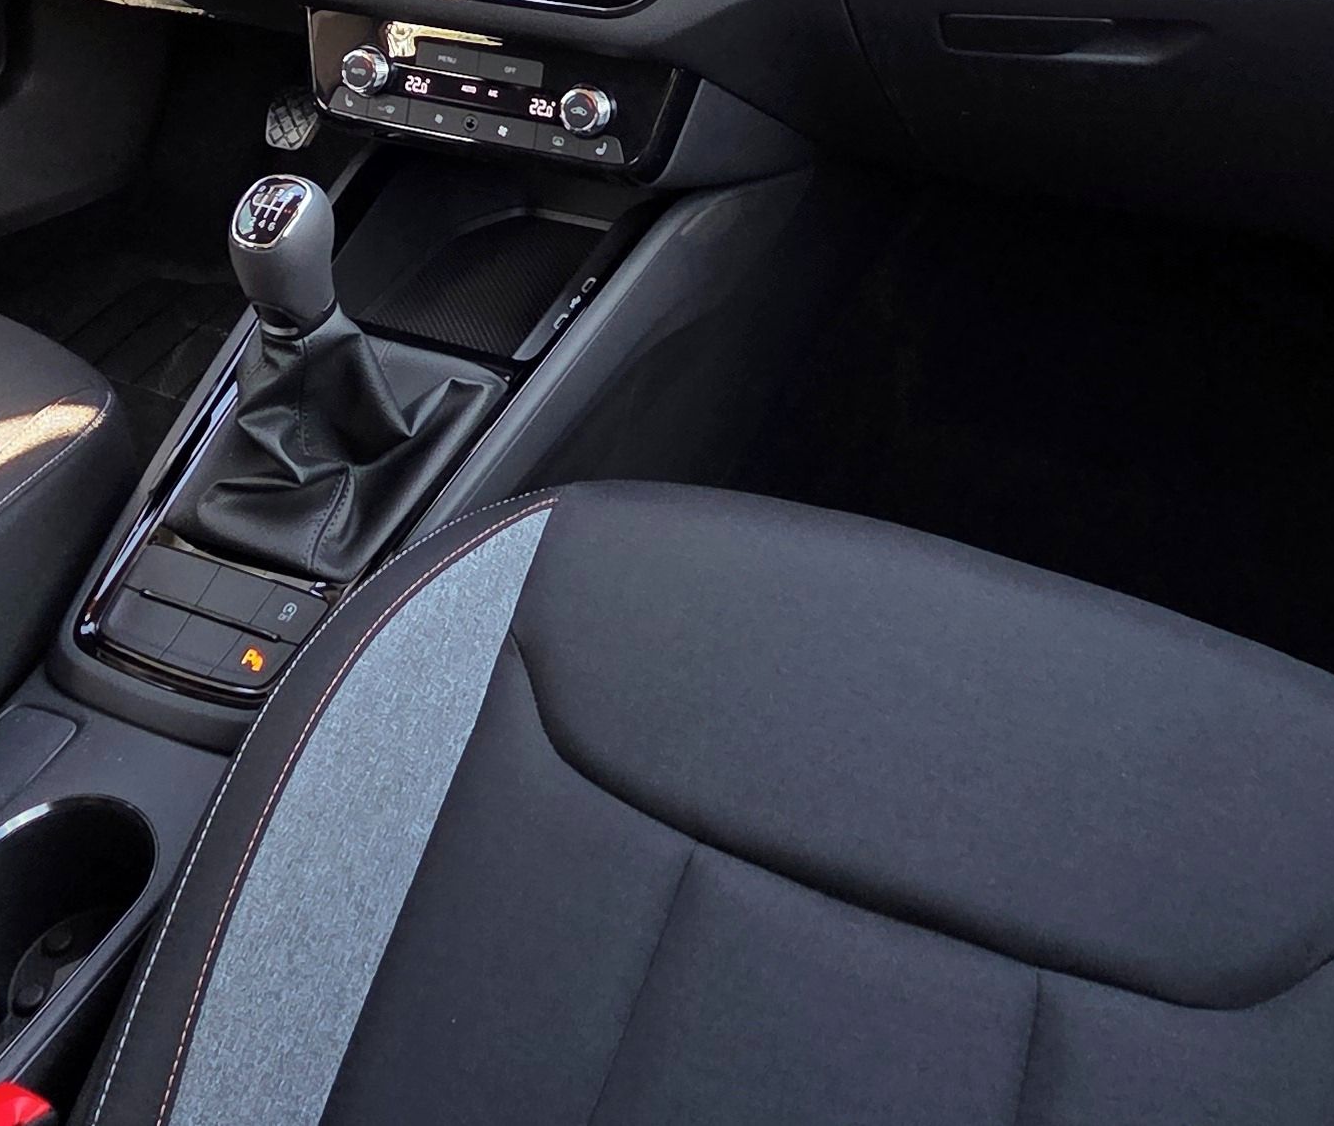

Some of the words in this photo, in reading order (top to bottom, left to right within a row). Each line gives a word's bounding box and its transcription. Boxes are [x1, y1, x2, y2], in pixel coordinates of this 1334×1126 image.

[437, 54, 457, 65] MENU
[503, 65, 517, 74] OFF
[258, 219, 266, 229] 4
[267, 221, 276, 232] 6
